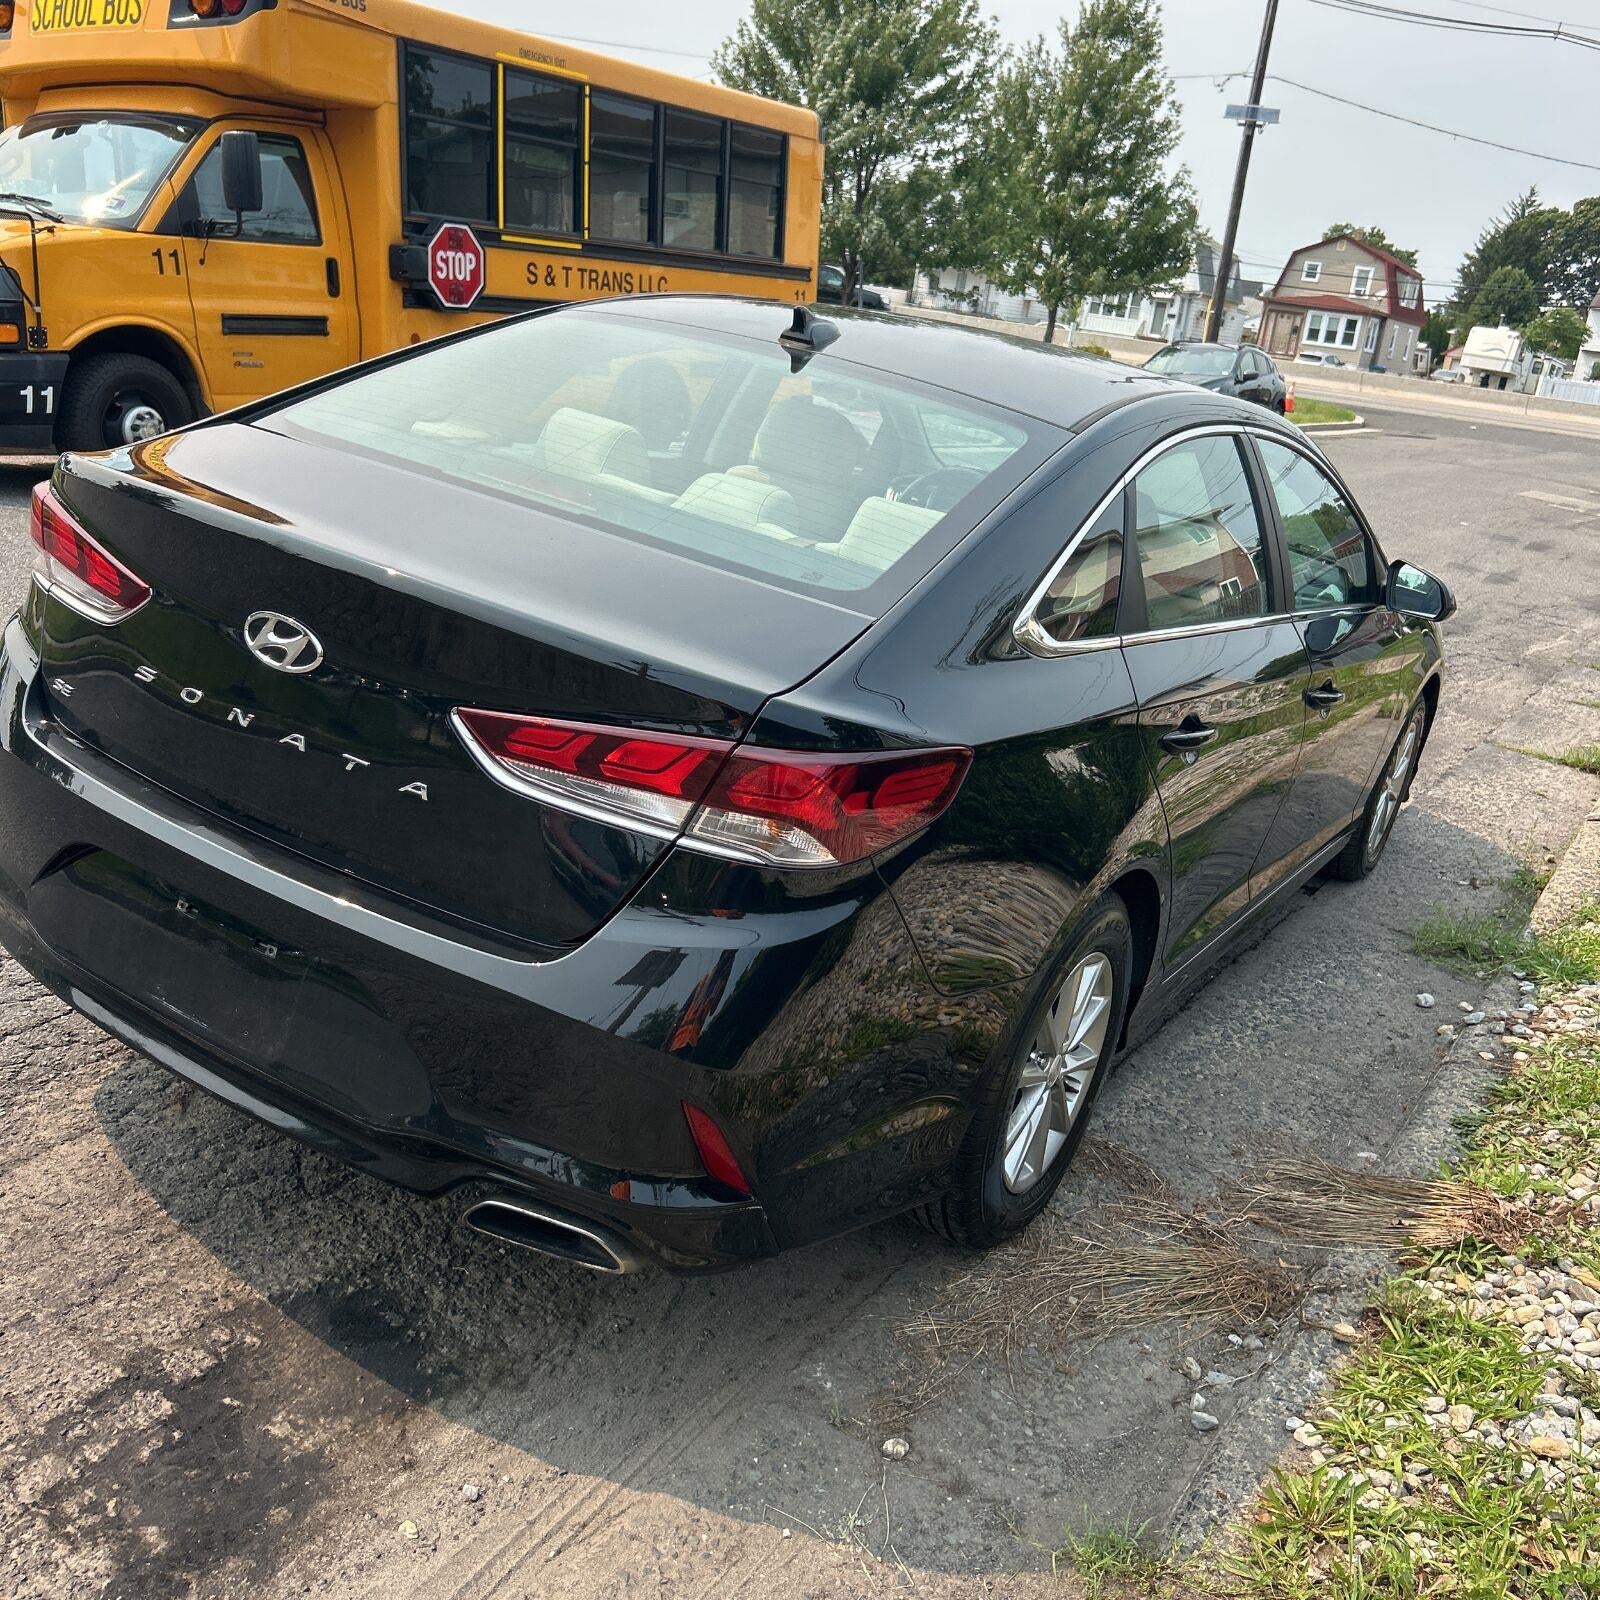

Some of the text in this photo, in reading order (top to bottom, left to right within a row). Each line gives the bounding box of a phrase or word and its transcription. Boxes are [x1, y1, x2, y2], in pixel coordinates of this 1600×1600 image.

[32, 0, 141, 31] SCHOOL BUS
[152, 248, 181, 275] 11
[436, 250, 476, 281] STOP
[526, 262, 538, 285] S
[544, 264, 556, 287] &
[562, 266, 572, 288] T
[577, 267, 633, 293] TRANS
[794, 290, 806, 301] 11
[20, 385, 53, 413] 11
[53, 678, 75, 697] SE
[134, 665, 428, 800] SONATA
